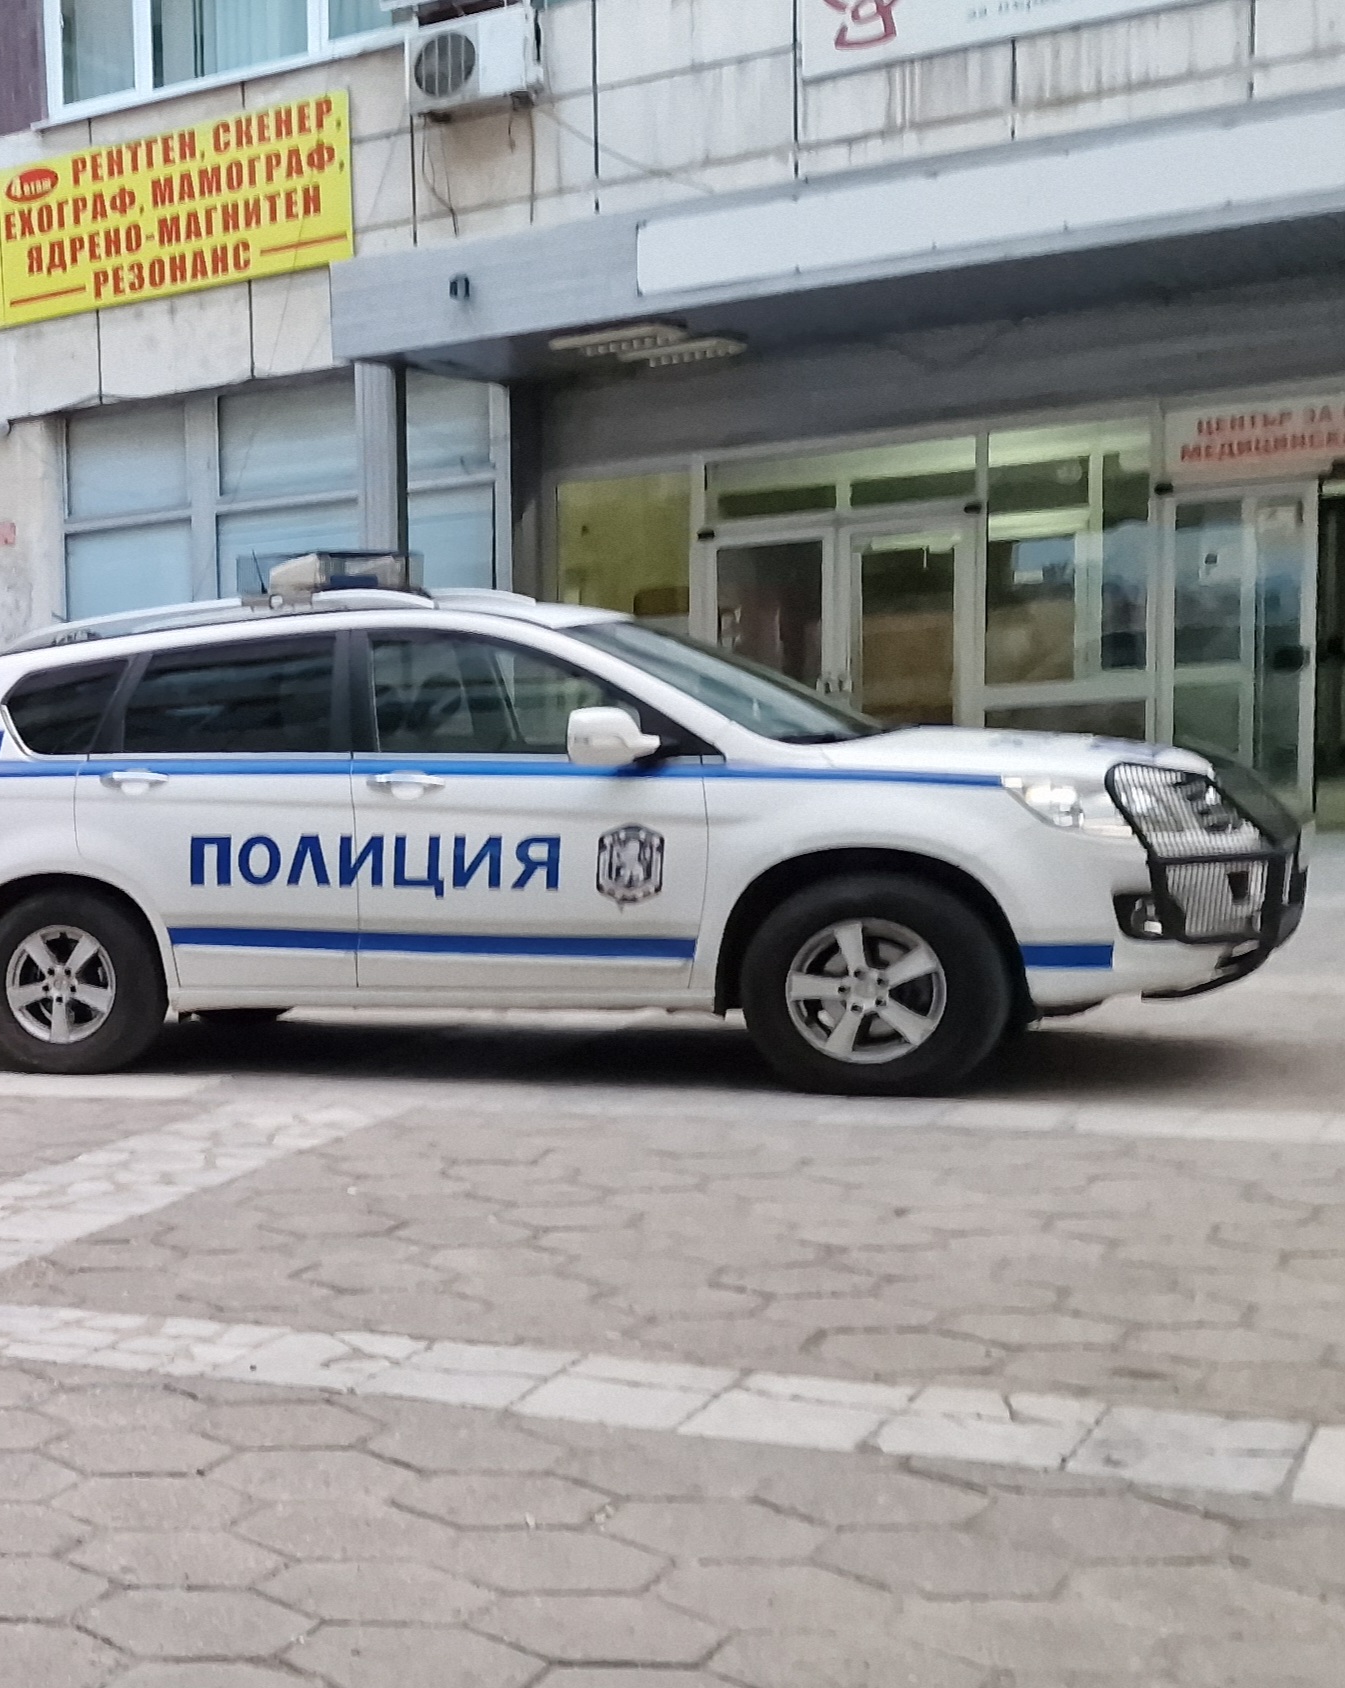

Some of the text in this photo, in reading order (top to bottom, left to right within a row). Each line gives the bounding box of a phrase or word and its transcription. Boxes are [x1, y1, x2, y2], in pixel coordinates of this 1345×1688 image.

[71, 98, 342, 188] РЕНТГЕН, СКЕНЕР,
[5, 141, 345, 242] ЕХОГРАФ, МАМОГРАФ,
[93, 239, 252, 301] РЕЗОНАНС
[1181, 430, 1345, 463] МЕДИЦИНСК
[1197, 408, 1292, 436] ЦЕНТЪР
[189, 834, 562, 900] ПОЛИЦИЯ
